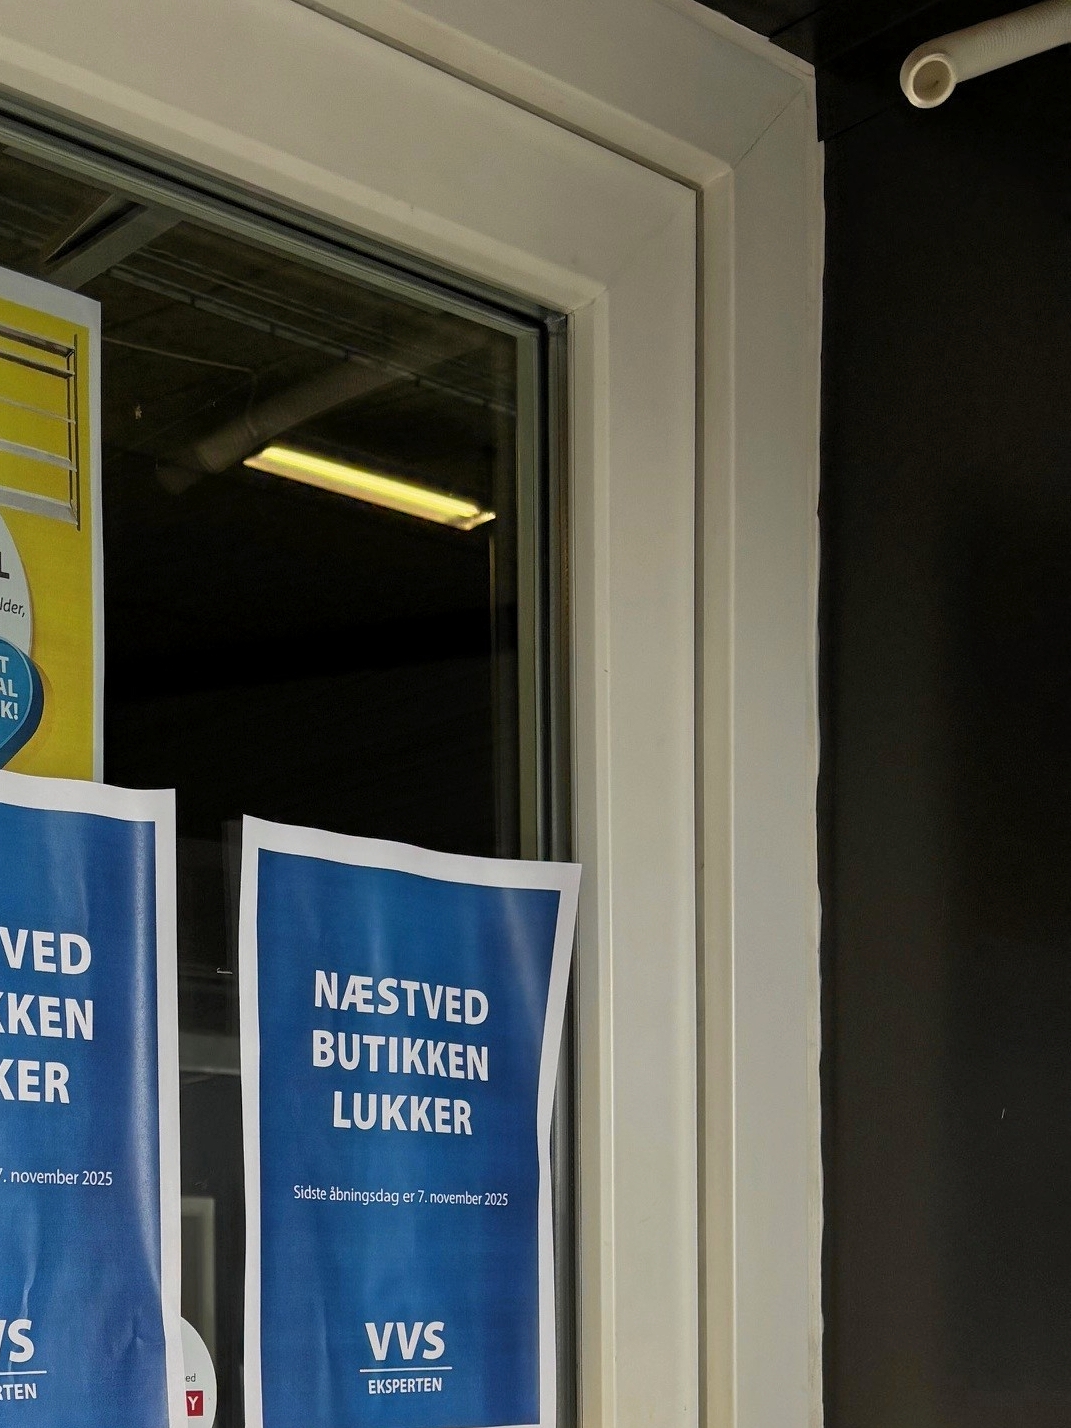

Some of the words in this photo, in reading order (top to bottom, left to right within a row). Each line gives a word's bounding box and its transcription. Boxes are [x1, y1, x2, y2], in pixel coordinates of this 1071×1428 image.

[314, 969, 489, 1025] NÆSTVED
[312, 1030, 489, 1082] BUTIKKEN
[333, 1091, 473, 1135] LUKKER
[11, 1169, 78, 1185] november
[82, 1170, 113, 1186] 2025
[293, 1185, 326, 1200] Sidste
[330, 1187, 399, 1205] åbningsdag
[403, 1191, 415, 1203] er
[418, 1190, 428, 1203] 7.
[431, 1191, 482, 1205] november
[485, 1193, 508, 1206] 2025
[365, 1321, 445, 1360] VVS
[368, 1377, 442, 1394] EKSPERTEN
